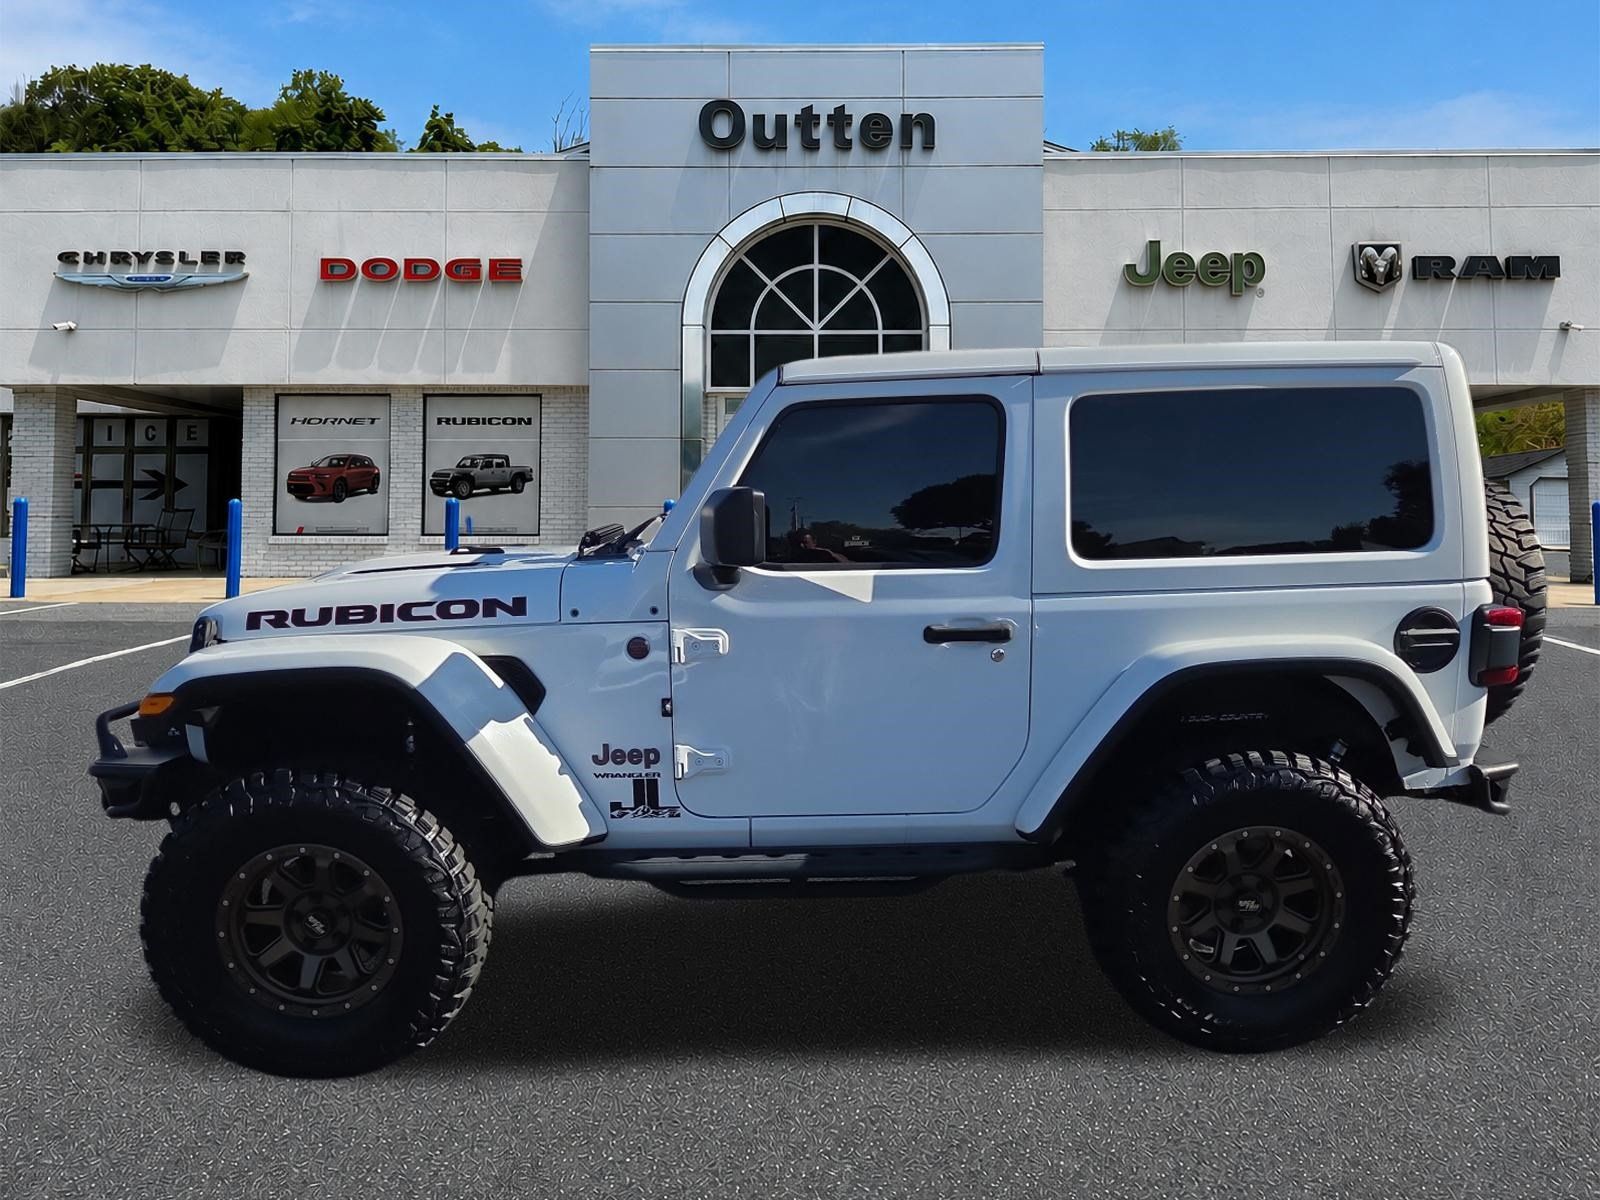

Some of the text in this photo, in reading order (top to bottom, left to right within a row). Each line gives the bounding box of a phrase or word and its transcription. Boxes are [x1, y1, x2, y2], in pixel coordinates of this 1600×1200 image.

[699, 99, 935, 150] Outten
[57, 250, 247, 267] CHRYSLER
[320, 256, 523, 282] DODGE
[1123, 239, 1266, 296] Jeep
[1411, 254, 1561, 281] RAM
[290, 416, 380, 426] HORNET
[436, 416, 533, 426] RUBICON
[246, 596, 527, 631] RUBICON
[592, 743, 660, 768] Jeep
[610, 778, 681, 818] JL
